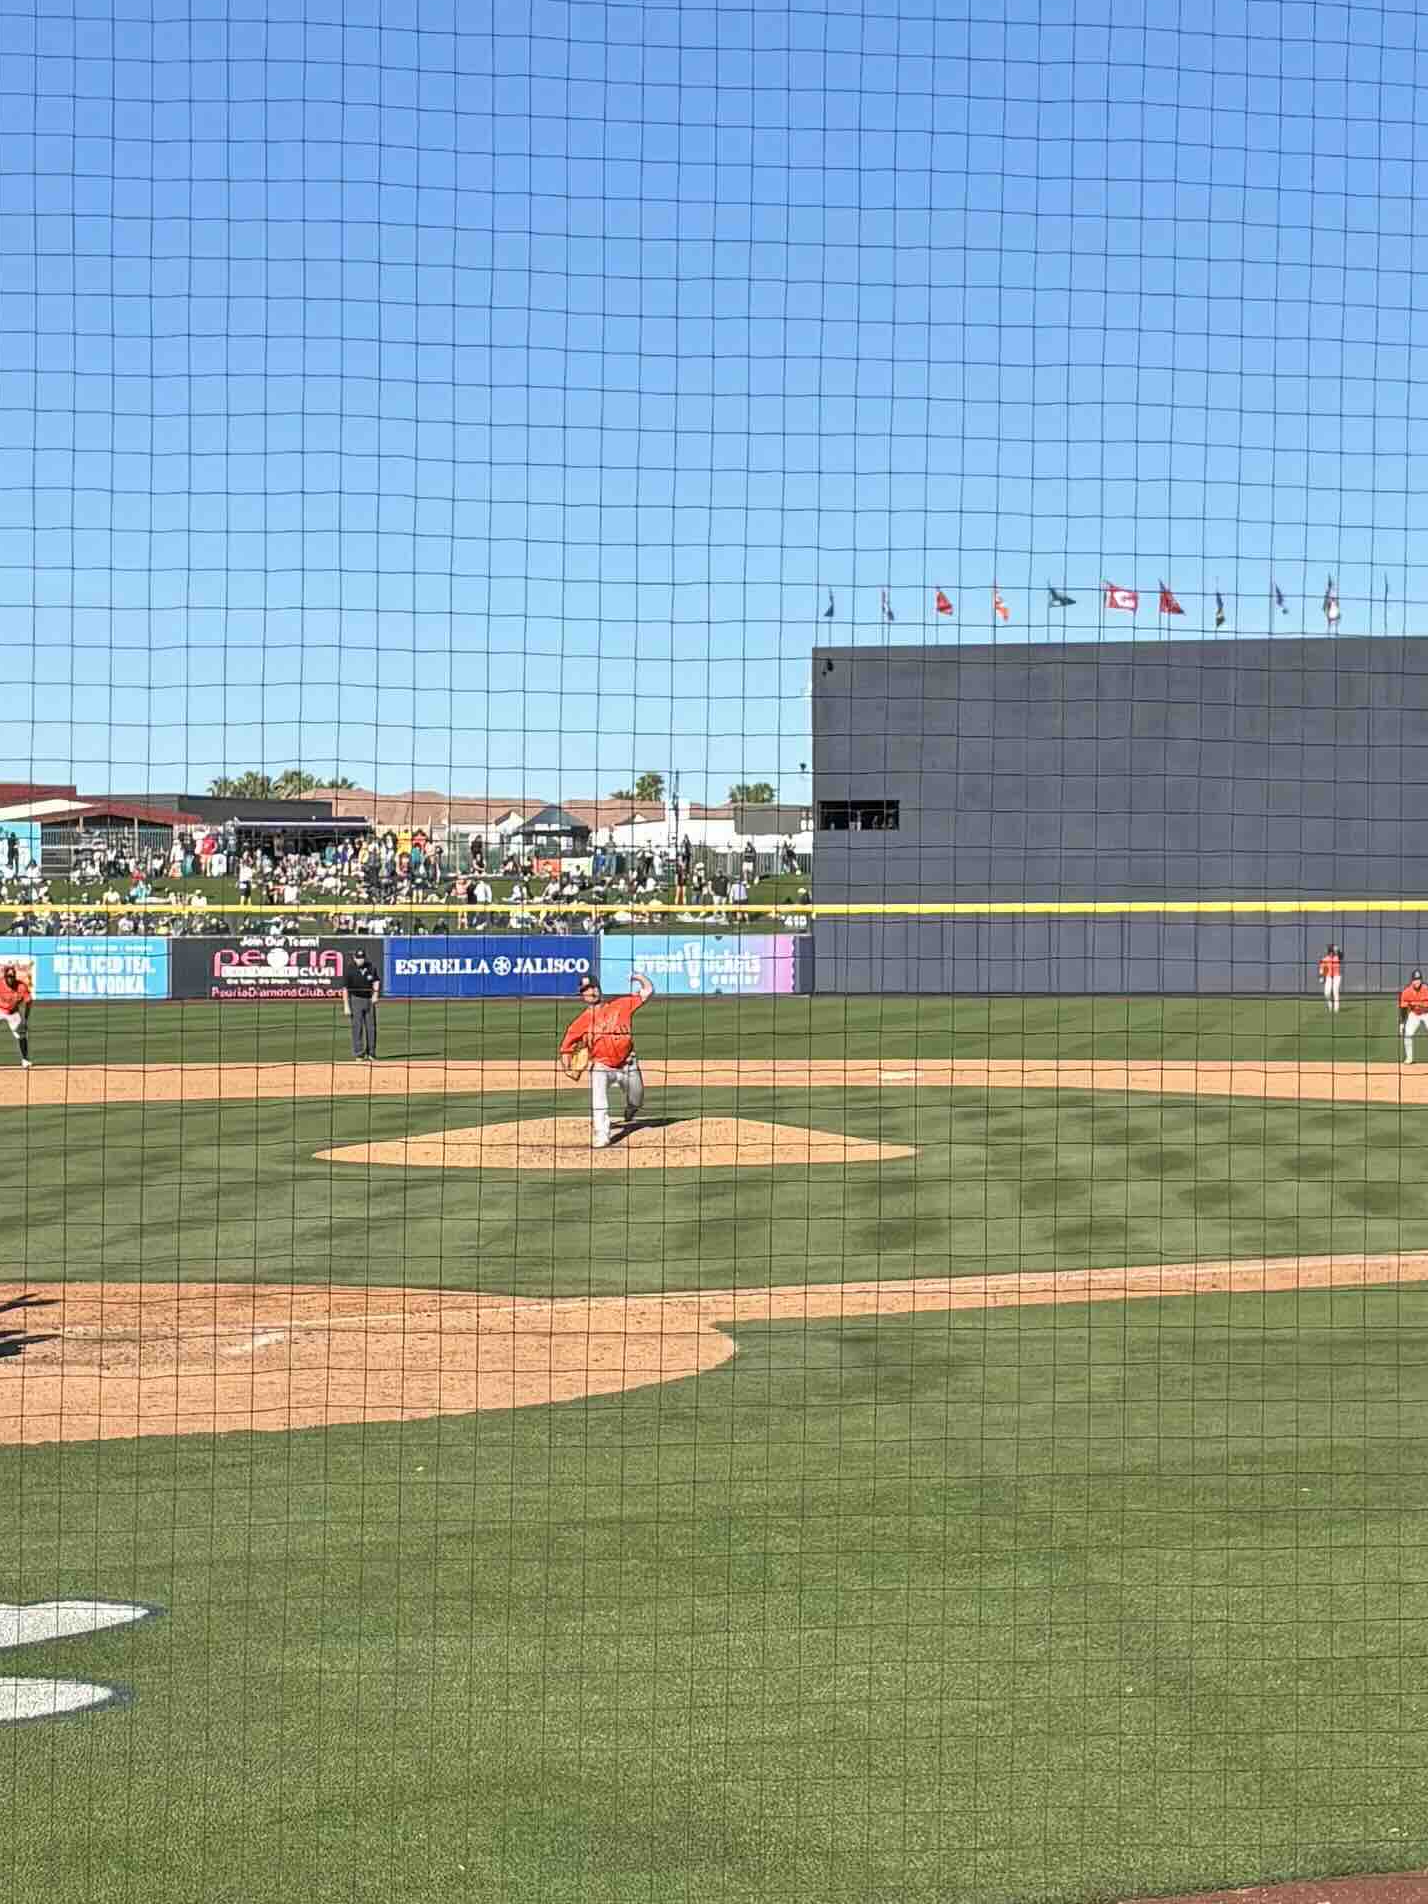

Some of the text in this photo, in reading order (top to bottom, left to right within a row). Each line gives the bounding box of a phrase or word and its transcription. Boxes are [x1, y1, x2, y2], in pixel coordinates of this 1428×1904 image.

[240, 936, 319, 947] Join Our Team!
[54, 956, 89, 974] REAL
[92, 956, 122, 974] ICED
[395, 958, 590, 975] ESTRELLA JALISCO
